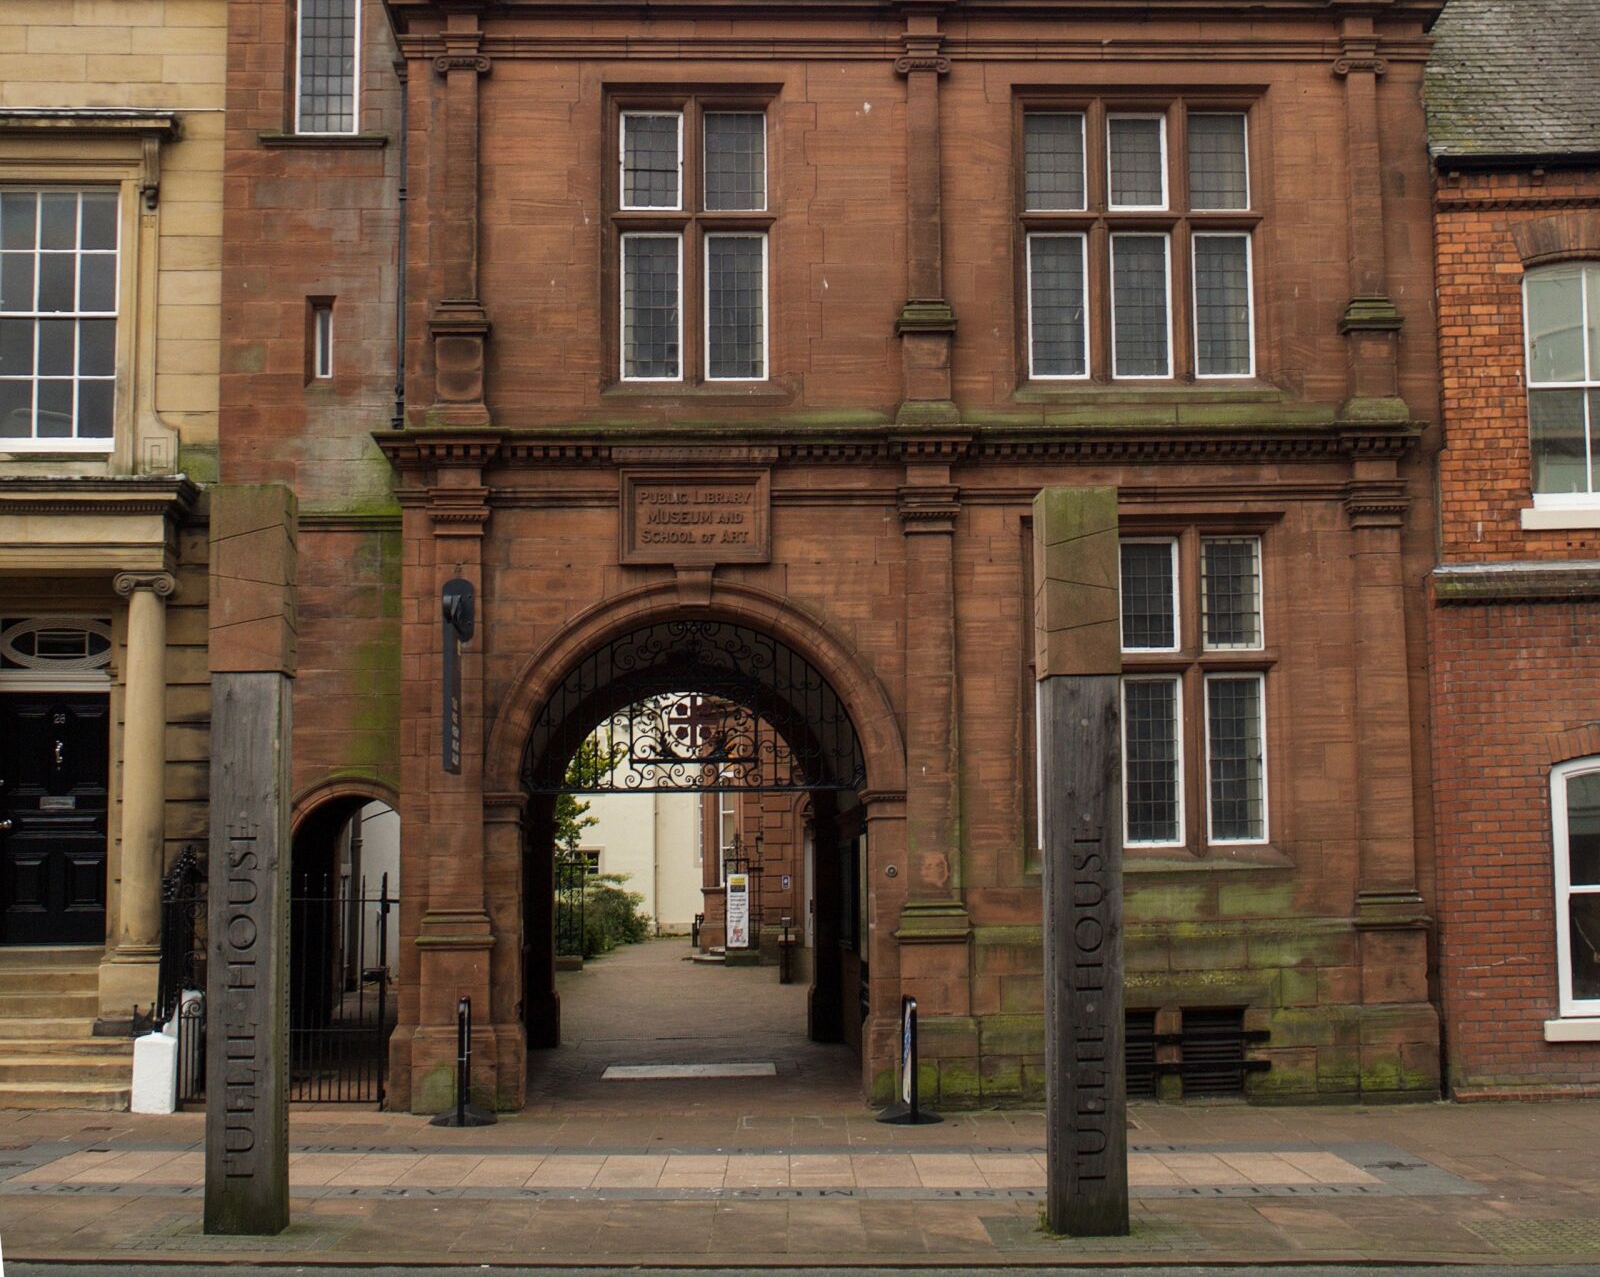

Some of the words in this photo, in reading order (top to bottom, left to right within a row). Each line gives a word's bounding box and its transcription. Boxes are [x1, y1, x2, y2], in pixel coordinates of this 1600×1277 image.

[639, 491, 689, 505] PUBLIC
[693, 489, 751, 505] LIBRARY
[641, 530, 696, 544] SCHOOL
[720, 530, 749, 544] ART
[647, 509, 713, 525] MUSEUM
[717, 512, 744, 524] AND
[225, 823, 260, 991] HOUSE
[1073, 825, 1106, 992] HOUSE
[223, 1022, 260, 1195] TULLIE
[1073, 1024, 1109, 1196] TULLIE
